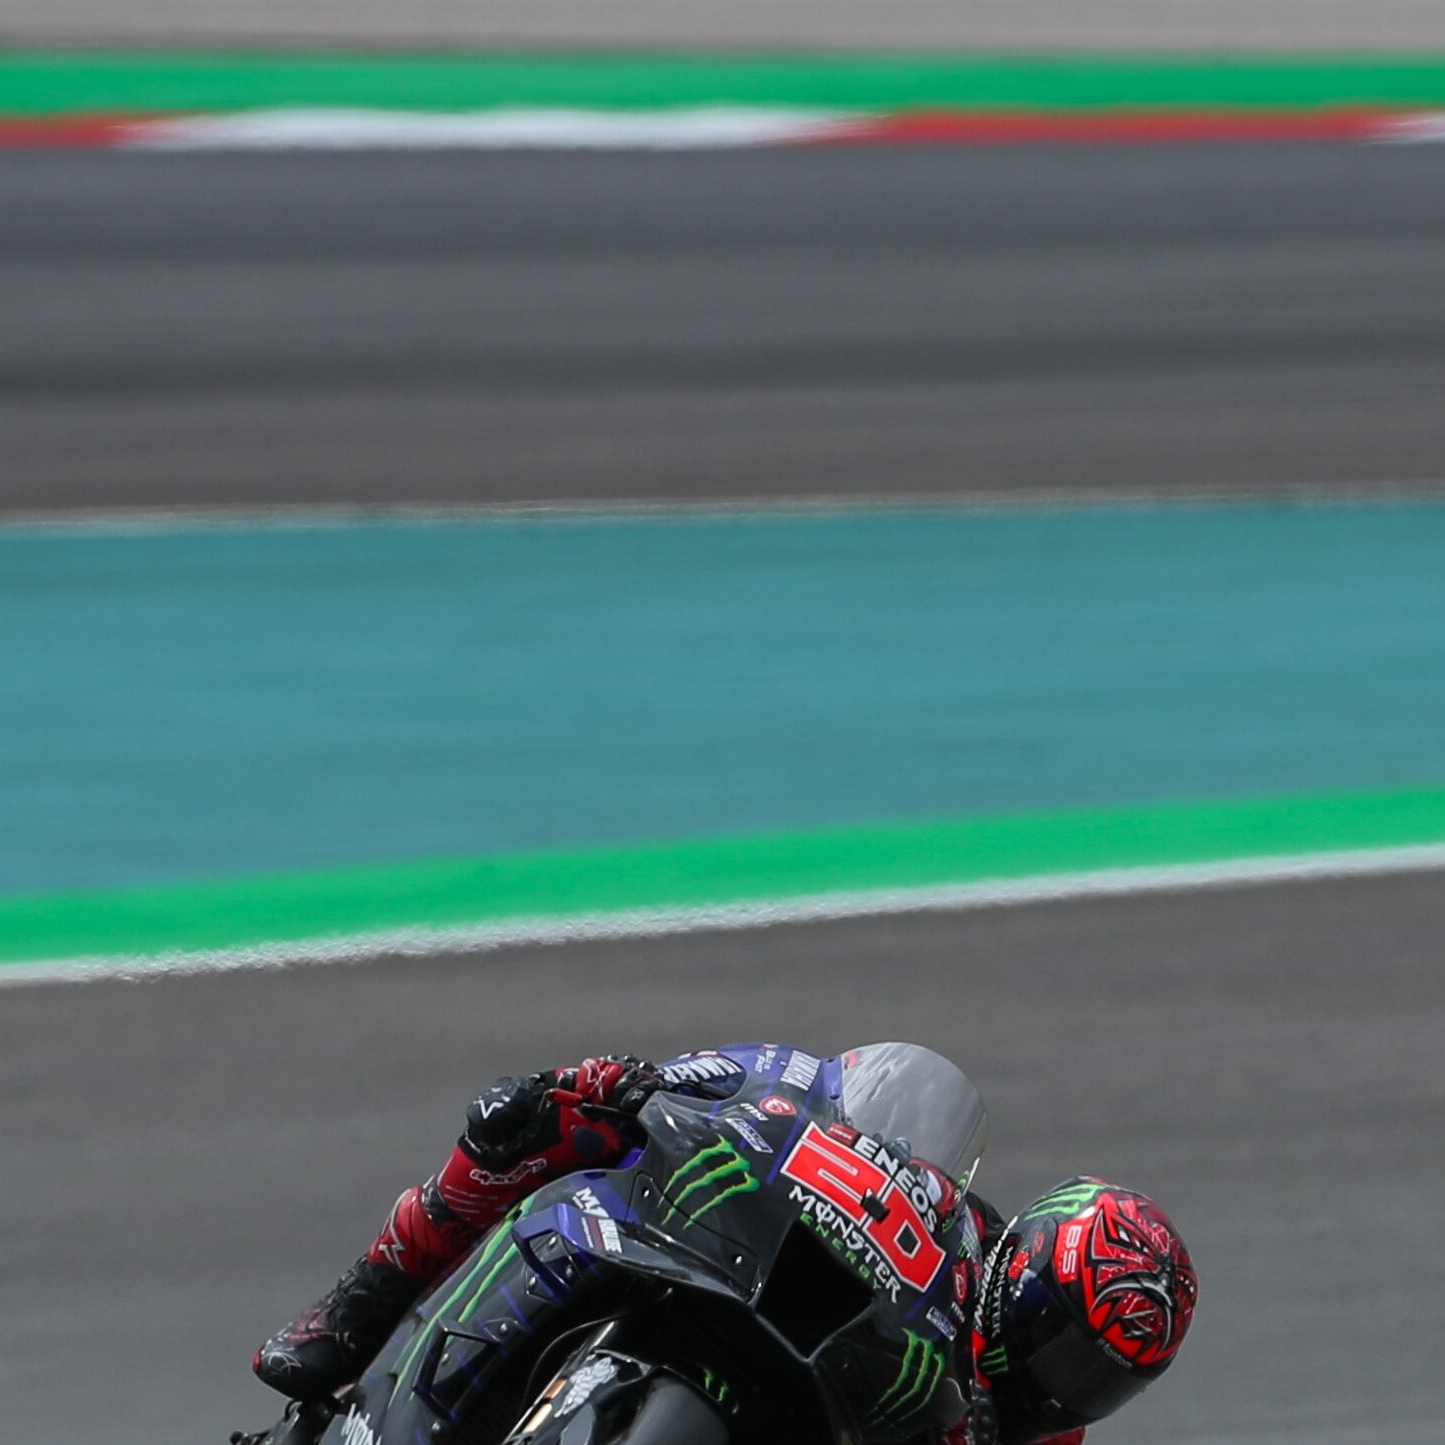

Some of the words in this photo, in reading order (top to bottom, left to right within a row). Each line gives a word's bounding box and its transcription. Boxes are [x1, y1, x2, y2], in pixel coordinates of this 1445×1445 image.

[854, 1134, 938, 1233] ENEOS
[788, 1185, 901, 1304] MONSTER
[799, 1212, 883, 1291] ENERGY
[1062, 1224, 1084, 1274] BS
